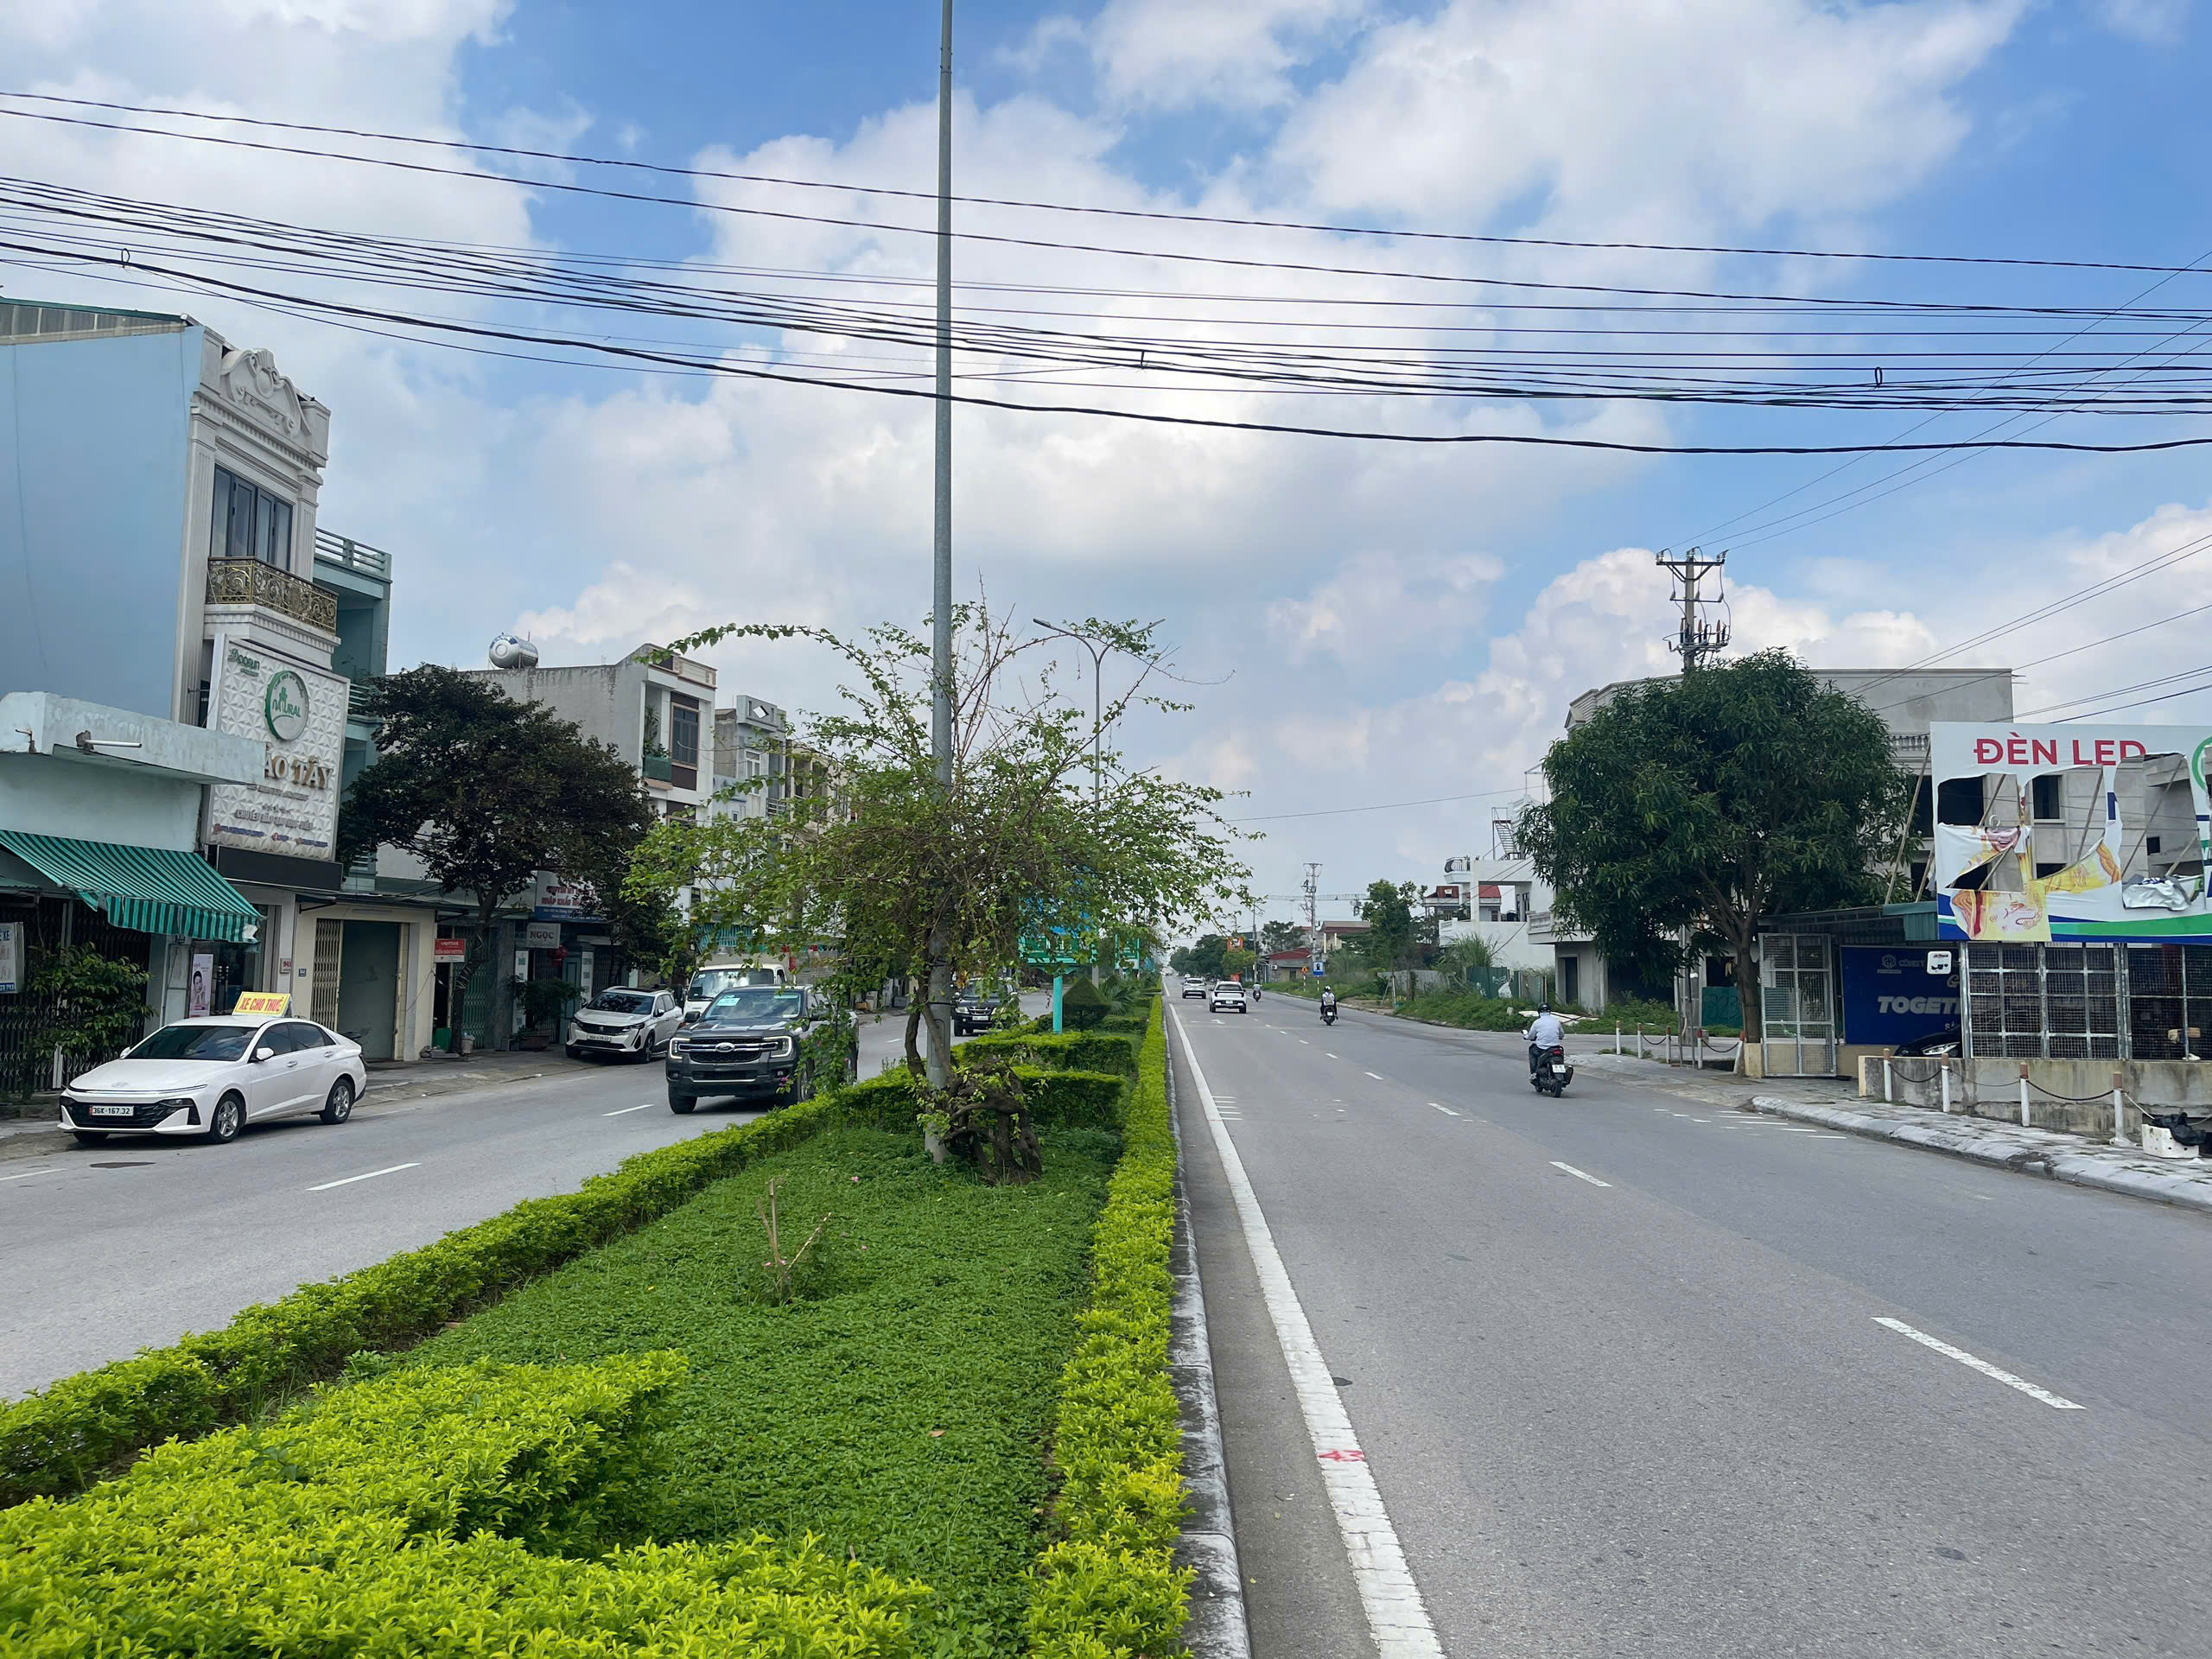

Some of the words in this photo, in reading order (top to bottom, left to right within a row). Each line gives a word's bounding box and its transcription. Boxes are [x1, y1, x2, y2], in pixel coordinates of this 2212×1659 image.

[1974, 732, 2058, 765] ĐÈN
[2072, 740, 2146, 766] LED
[292, 755, 334, 790] TÂY
[530, 931, 554, 941] NGỌC
[239, 997, 250, 1010] XE
[249, 998, 266, 1011] CHO
